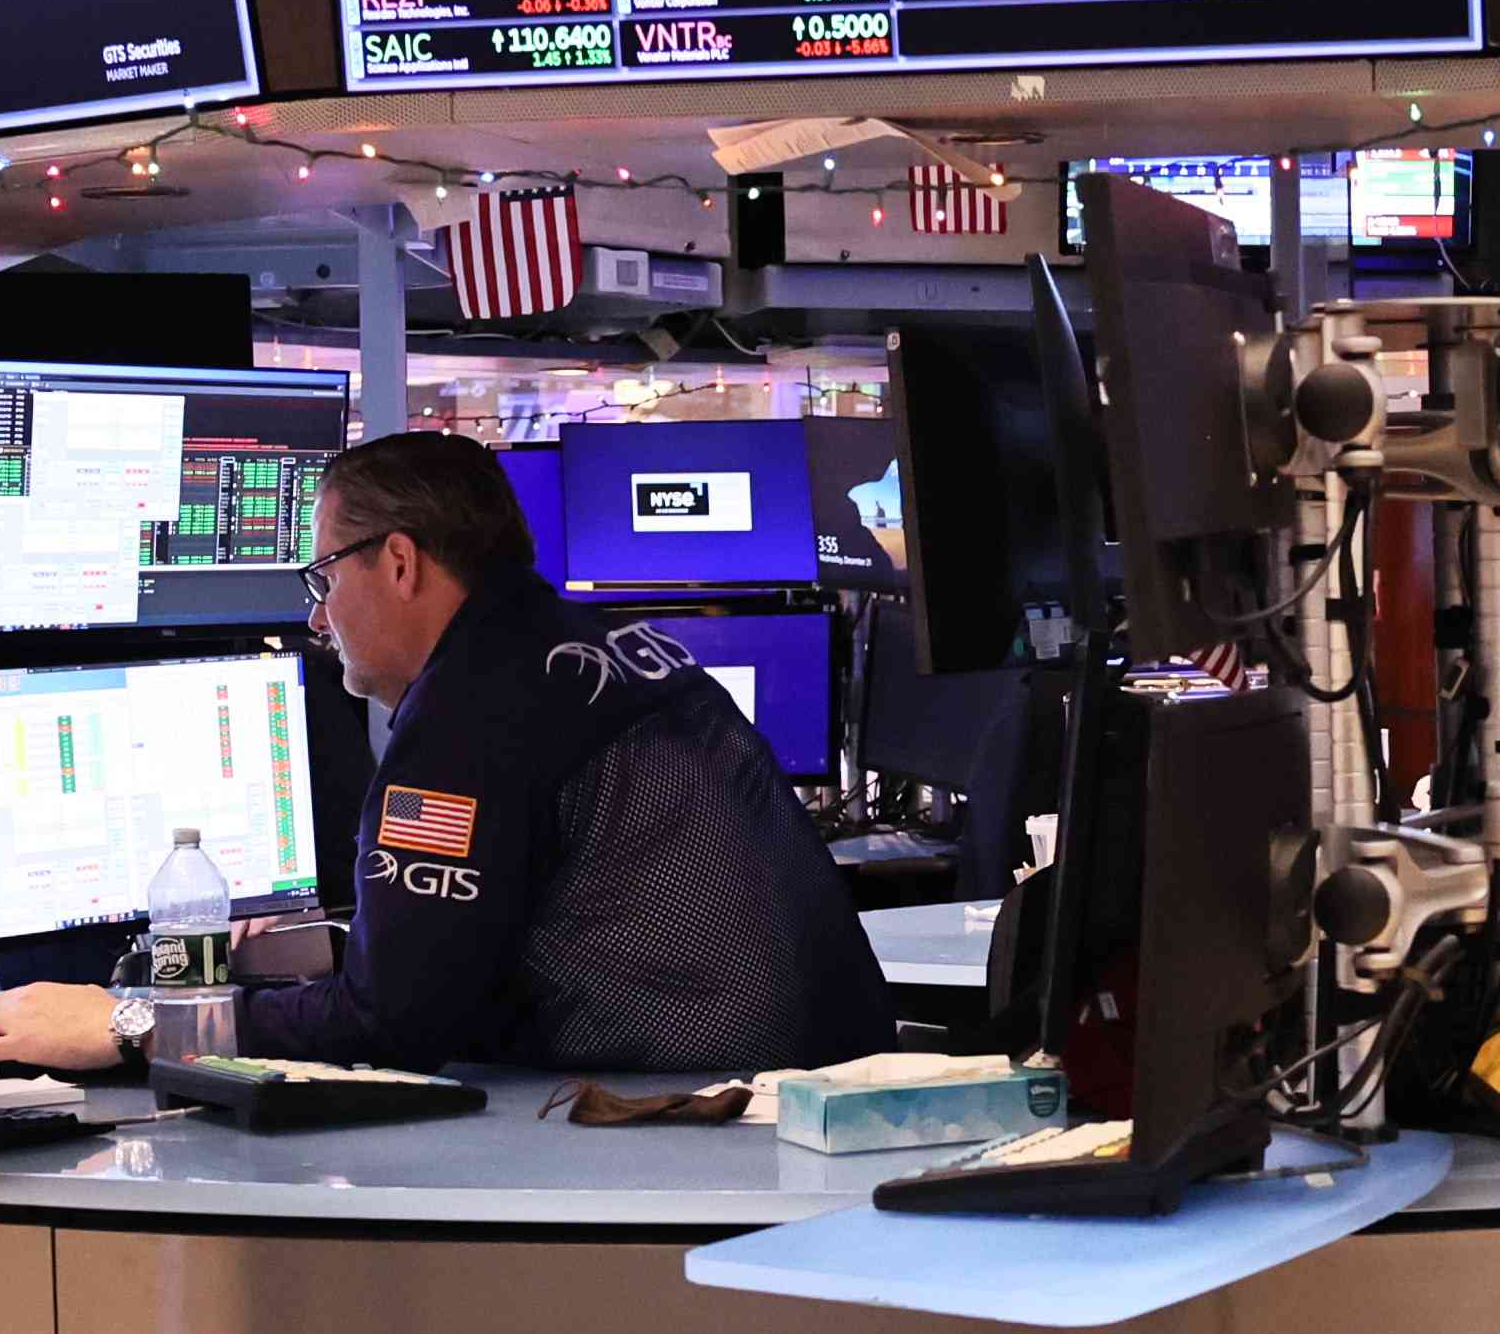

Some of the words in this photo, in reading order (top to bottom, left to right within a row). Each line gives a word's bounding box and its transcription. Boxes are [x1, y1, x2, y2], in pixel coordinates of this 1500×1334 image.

[103, 43, 127, 64] GTS
[127, 37, 181, 60] Securities
[403, 862, 481, 901] GTS
